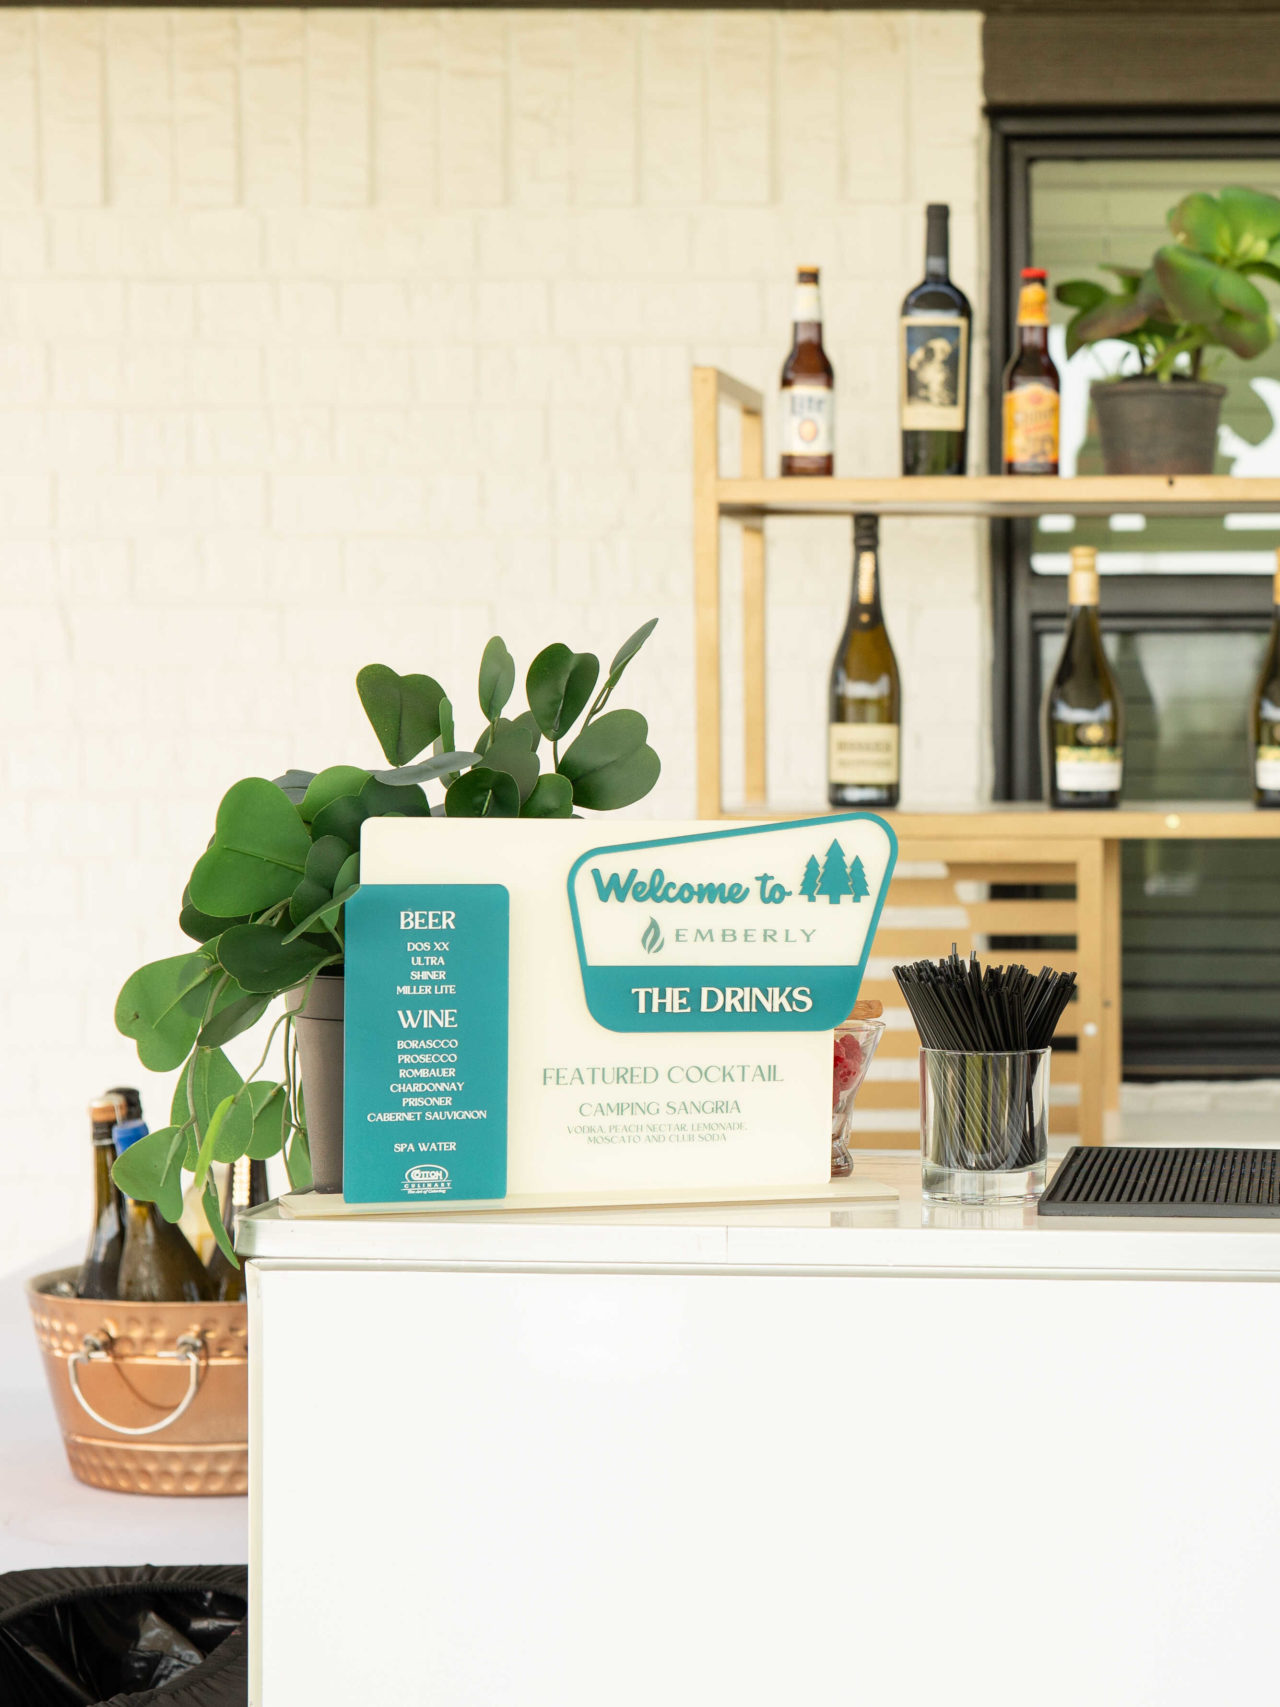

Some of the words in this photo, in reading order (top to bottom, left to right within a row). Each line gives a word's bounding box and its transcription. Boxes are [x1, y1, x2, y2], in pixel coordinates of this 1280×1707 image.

[590, 868, 750, 904] Welcome
[754, 872, 793, 905] to
[399, 910, 456, 930] BEER
[674, 928, 817, 943] EMBERLY
[406, 942, 431, 952] DOS
[433, 941, 450, 951] XX
[411, 956, 445, 966] ULTRA
[410, 971, 446, 980] SHINER
[396, 985, 432, 995] MILLER
[434, 984, 456, 994] LITE
[631, 987, 692, 1014] THE
[700, 986, 813, 1013] DRINKS
[397, 1009, 458, 1029] WINE
[397, 1039, 458, 1050] BORASCCO
[397, 1053, 458, 1064] PROSECCO
[399, 1068, 456, 1078] ROMBAUER
[542, 1066, 660, 1086] FEATURED
[667, 1064, 785, 1084] COCKTAIL
[389, 1082, 465, 1093] CHARDONNAY
[402, 1097, 453, 1107] PRISONER
[578, 1102, 661, 1117] CAMPING
[665, 1100, 742, 1115] SANGRIA
[367, 1112, 422, 1123] CABERNET
[424, 1110, 487, 1121] SAUVIGNON
[608, 1124, 644, 1134] PEACH
[586, 1134, 642, 1145] MOSCATO
[644, 1134, 666, 1143] AND
[668, 1133, 696, 1143] CLUB
[697, 1132, 728, 1142] SODA
[393, 1143, 416, 1153] SPA
[417, 1141, 457, 1152] WATER
